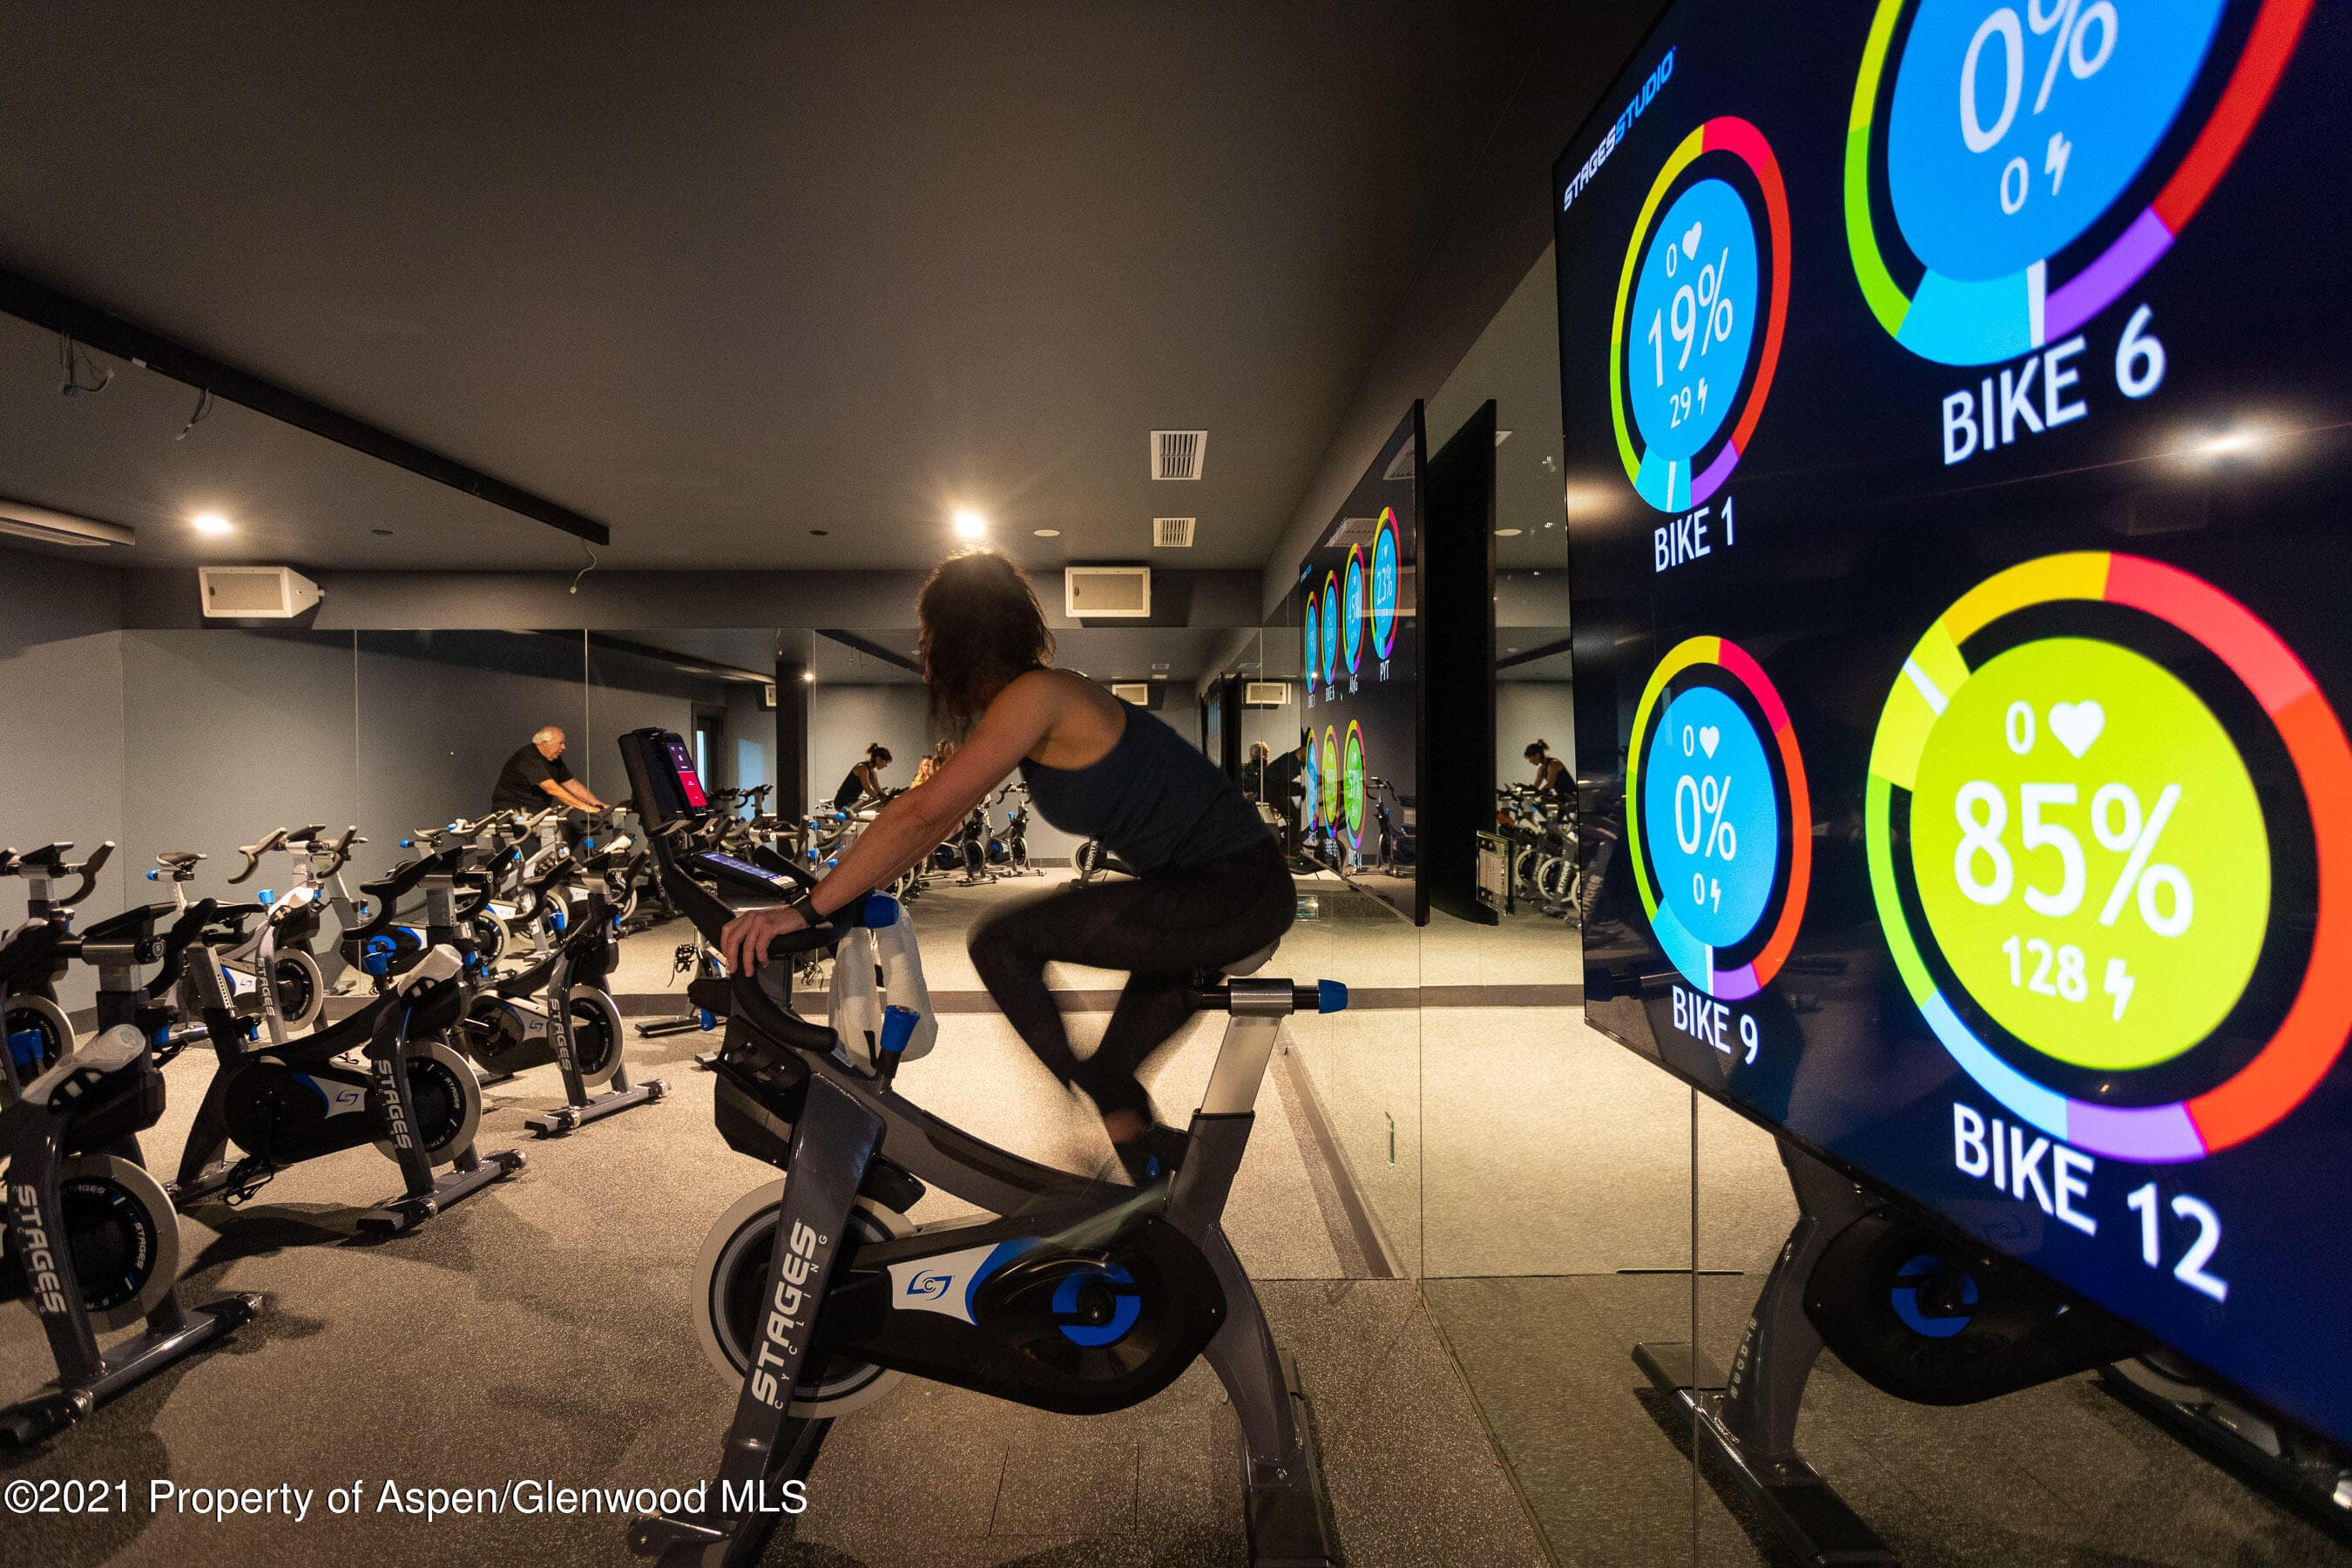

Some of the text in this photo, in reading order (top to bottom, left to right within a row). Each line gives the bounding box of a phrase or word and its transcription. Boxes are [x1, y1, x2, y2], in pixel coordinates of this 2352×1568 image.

[1960, 0, 2118, 153] 0%
[2000, 157, 2029, 215] 0
[1666, 243, 1677, 278] 0
[1648, 247, 1734, 388] 19%
[1670, 386, 1692, 429] 29
[1943, 305, 2166, 465] BIKE 6
[1654, 496, 1734, 572] BIKE 1
[1683, 725, 1694, 757] 0
[2005, 700, 2037, 755] 0
[1674, 774, 1737, 862] 0%
[1693, 872, 1706, 906] 0
[1954, 781, 2195, 938] 85%
[257, 957, 276, 1017] STAGES
[2002, 935, 2090, 1004] 128
[549, 998, 572, 1071] STAGES
[1673, 985, 1759, 1064] BIKE 9
[379, 1059, 413, 1149] STAGES
[445, 1077, 461, 1110] STAGES
[1953, 1102, 2227, 1302] BIKE 12
[17, 1185, 68, 1315] STAGES
[134, 1221, 147, 1271] STAGES
[751, 1220, 817, 1406] STAGES
[774, 1234, 828, 1410] CYCLING
